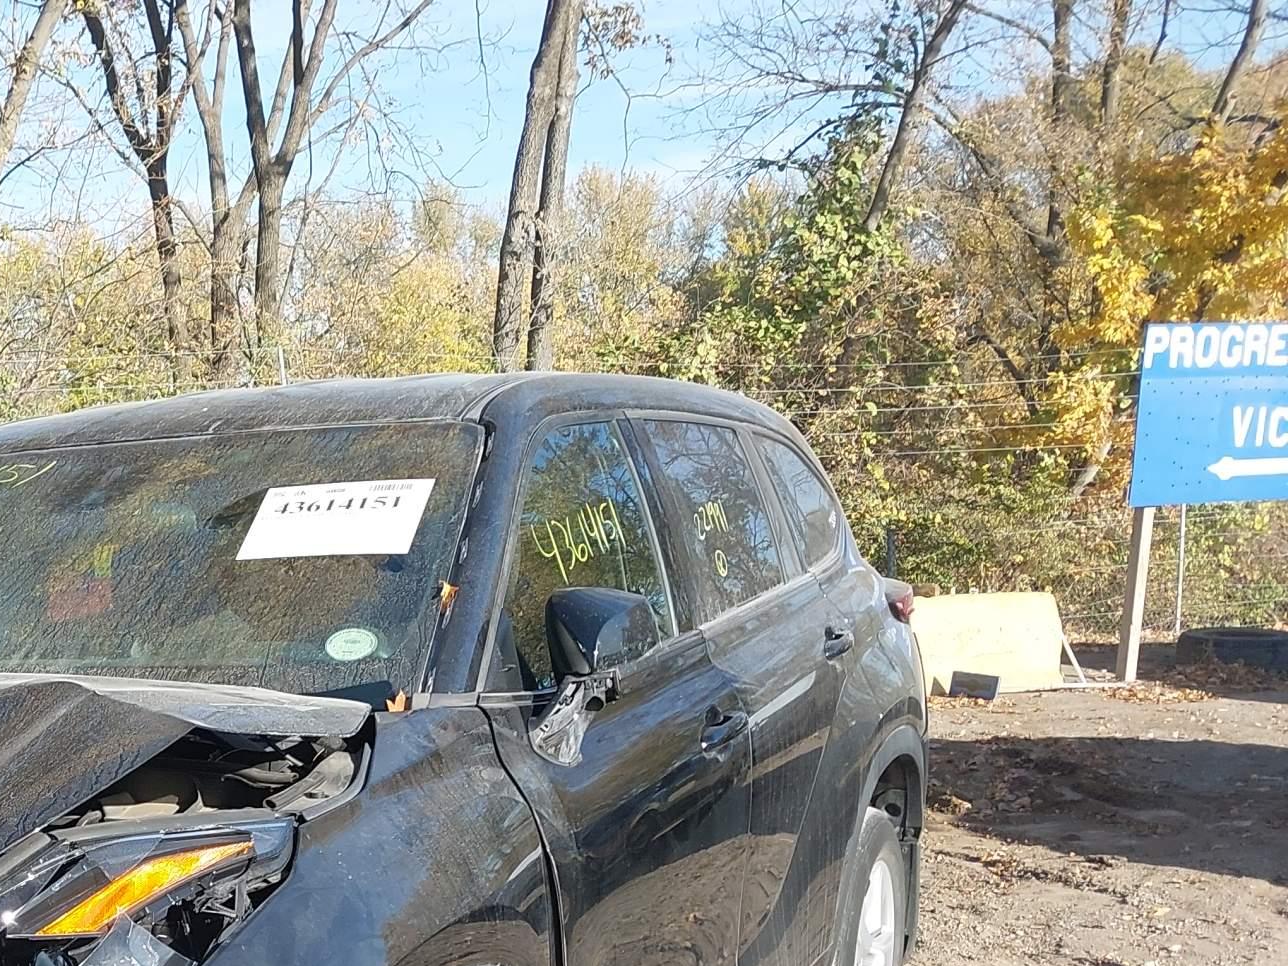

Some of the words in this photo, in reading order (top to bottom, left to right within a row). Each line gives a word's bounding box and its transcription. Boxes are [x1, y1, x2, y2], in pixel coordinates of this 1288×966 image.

[1144, 325, 1288, 368] PROGRE
[274, 496, 401, 514] 43614151
[530, 497, 626, 585] 43614151
